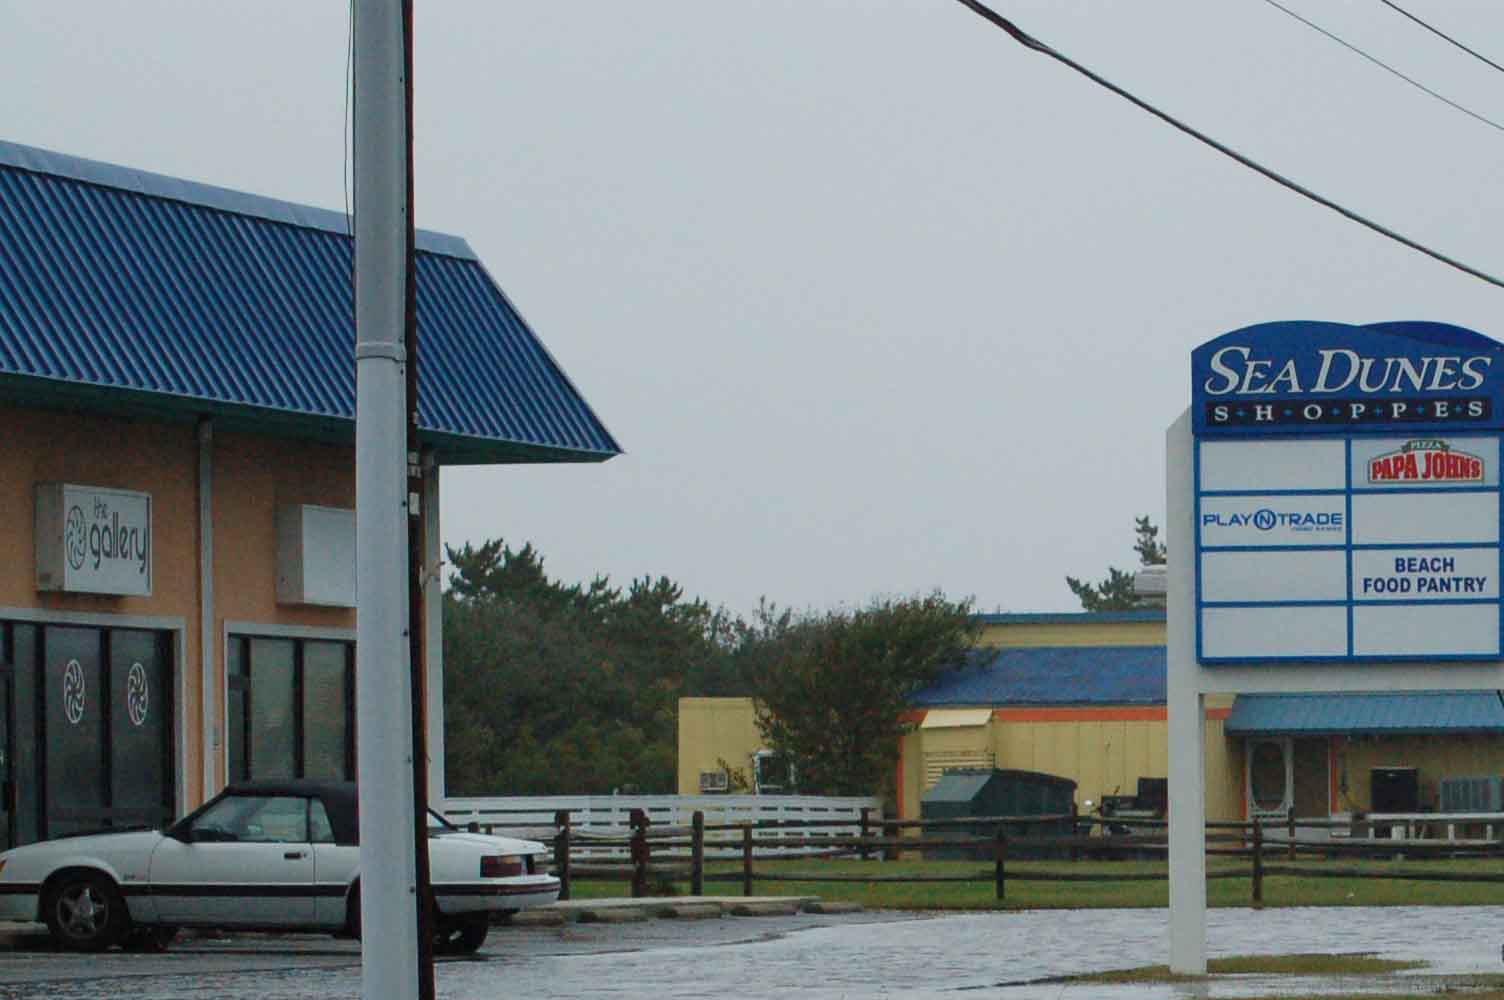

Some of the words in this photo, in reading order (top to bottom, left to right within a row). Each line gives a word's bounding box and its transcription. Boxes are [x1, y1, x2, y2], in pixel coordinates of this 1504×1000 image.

[1205, 346, 1302, 396] SEA
[1311, 347, 1492, 394] DUNES
[1372, 453, 1418, 480] PAPA
[93, 495, 109, 519] the
[89, 512, 148, 574] gallery
[1394, 556, 1456, 574] BEACH
[1362, 577, 1411, 593] FOOD
[1416, 576, 1487, 593] PANTRY
